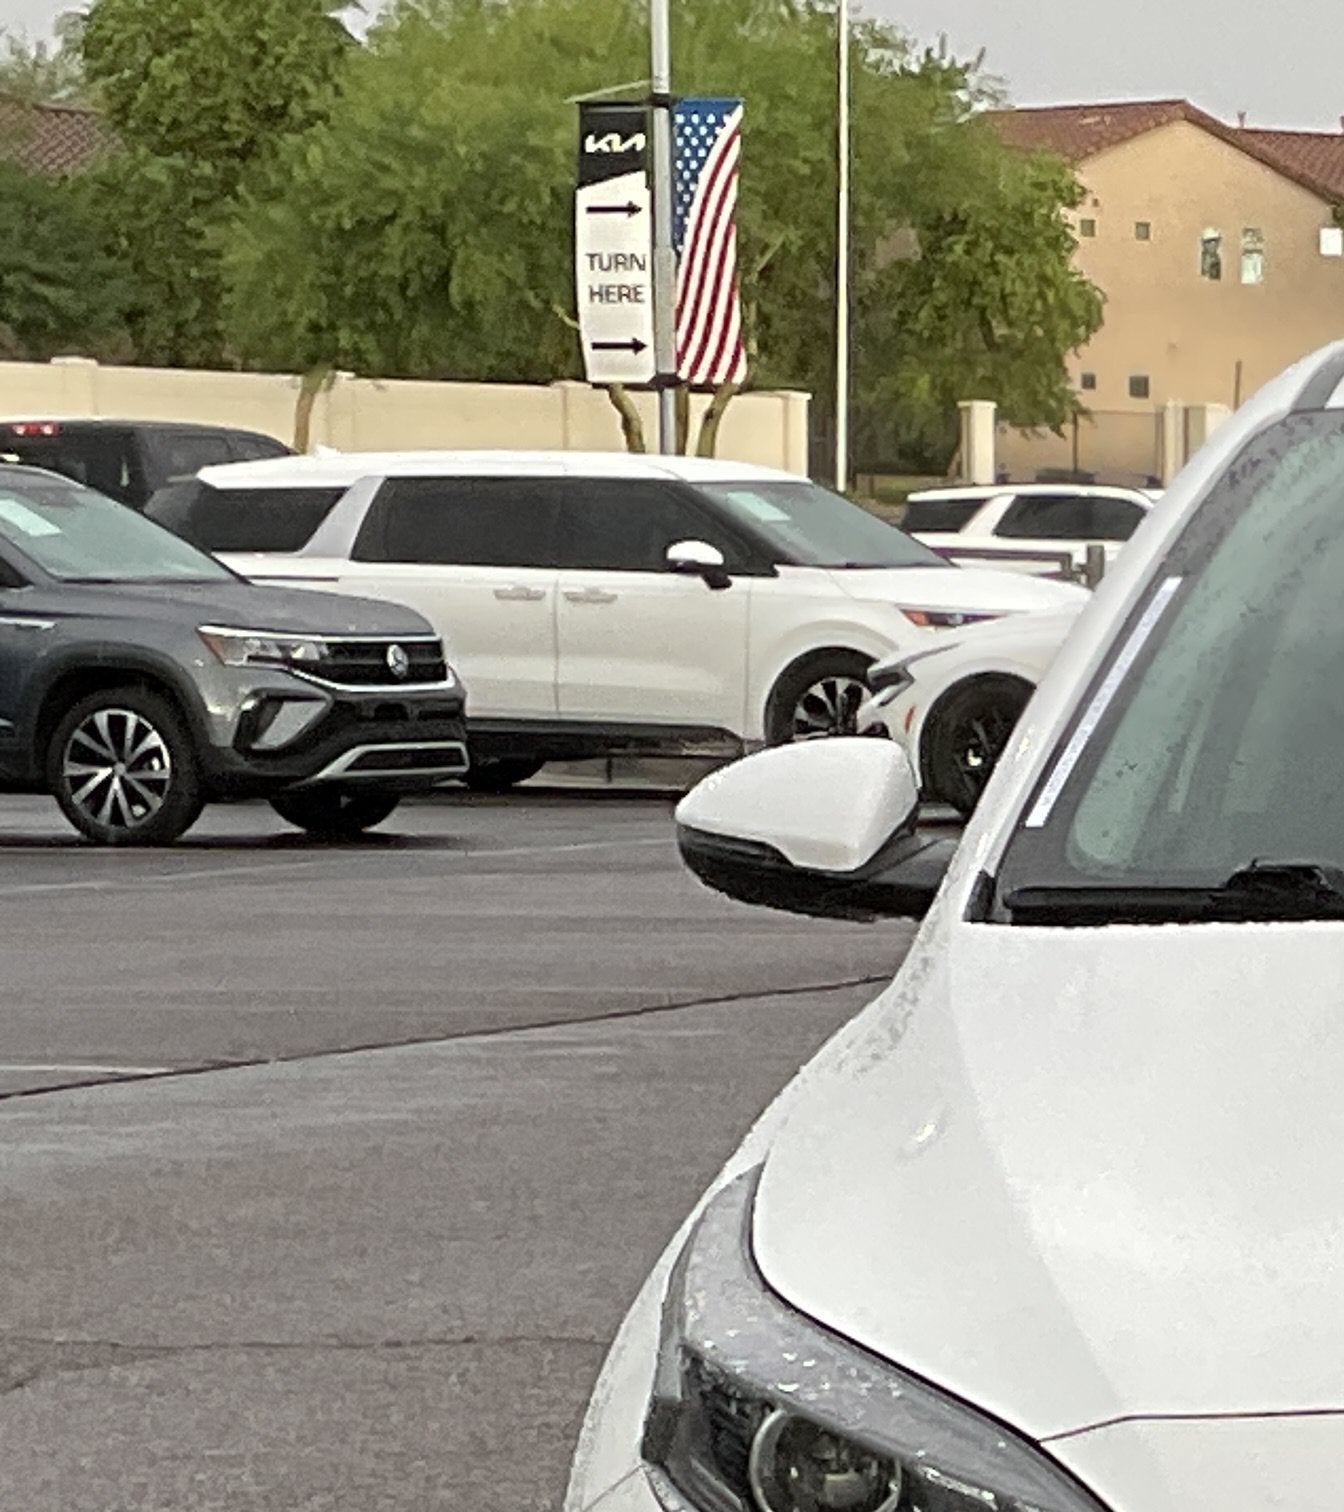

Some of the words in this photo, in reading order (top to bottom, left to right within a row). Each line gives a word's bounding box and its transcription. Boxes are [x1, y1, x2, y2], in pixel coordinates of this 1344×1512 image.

[585, 132, 646, 153] KIA
[585, 252, 646, 272] TURN
[588, 284, 646, 304] HERE
